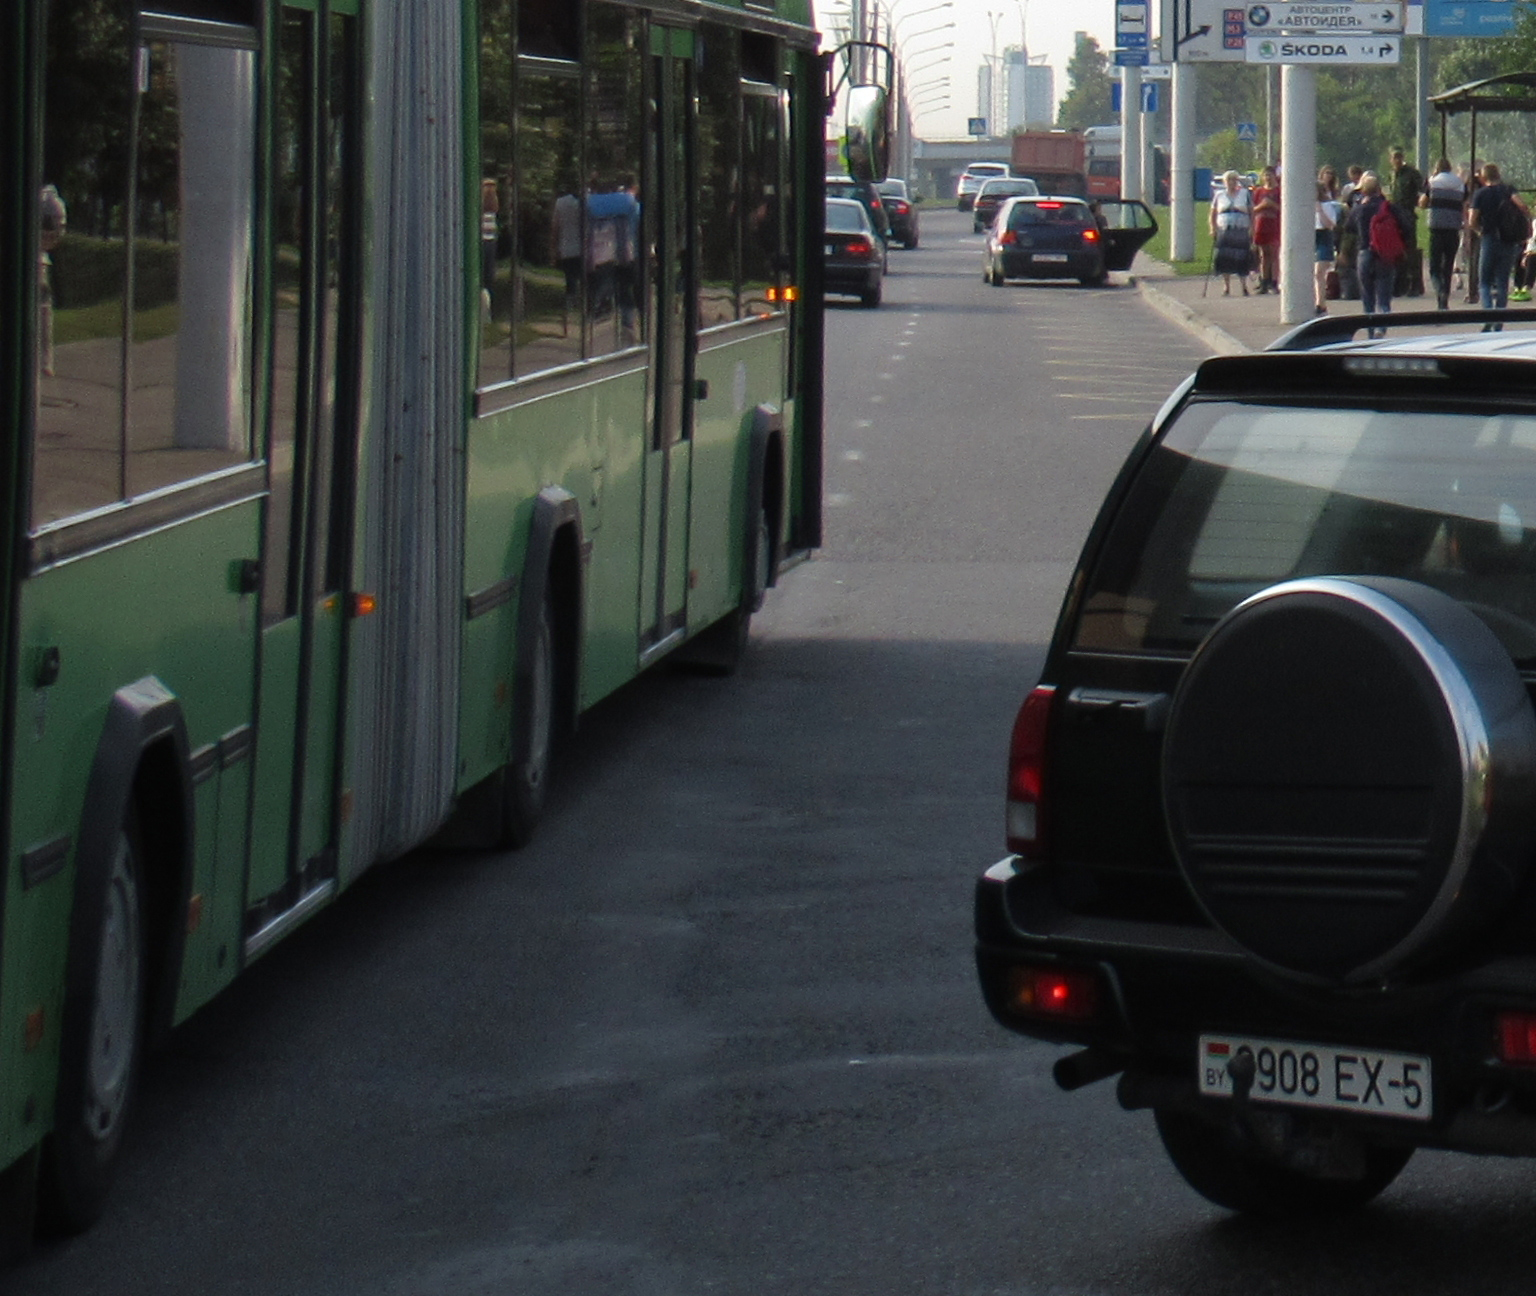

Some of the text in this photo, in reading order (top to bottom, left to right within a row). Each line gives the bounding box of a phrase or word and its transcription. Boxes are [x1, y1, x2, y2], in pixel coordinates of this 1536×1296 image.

[1290, 6, 1352, 15] АВТОЦЕНТР
[1278, 16, 1362, 27] «АВТОИДЕЯ»
[1281, 42, 1348, 57] ŠKODA
[1206, 1067, 1225, 1087] BY
[1335, 1054, 1423, 1110] EX-5
